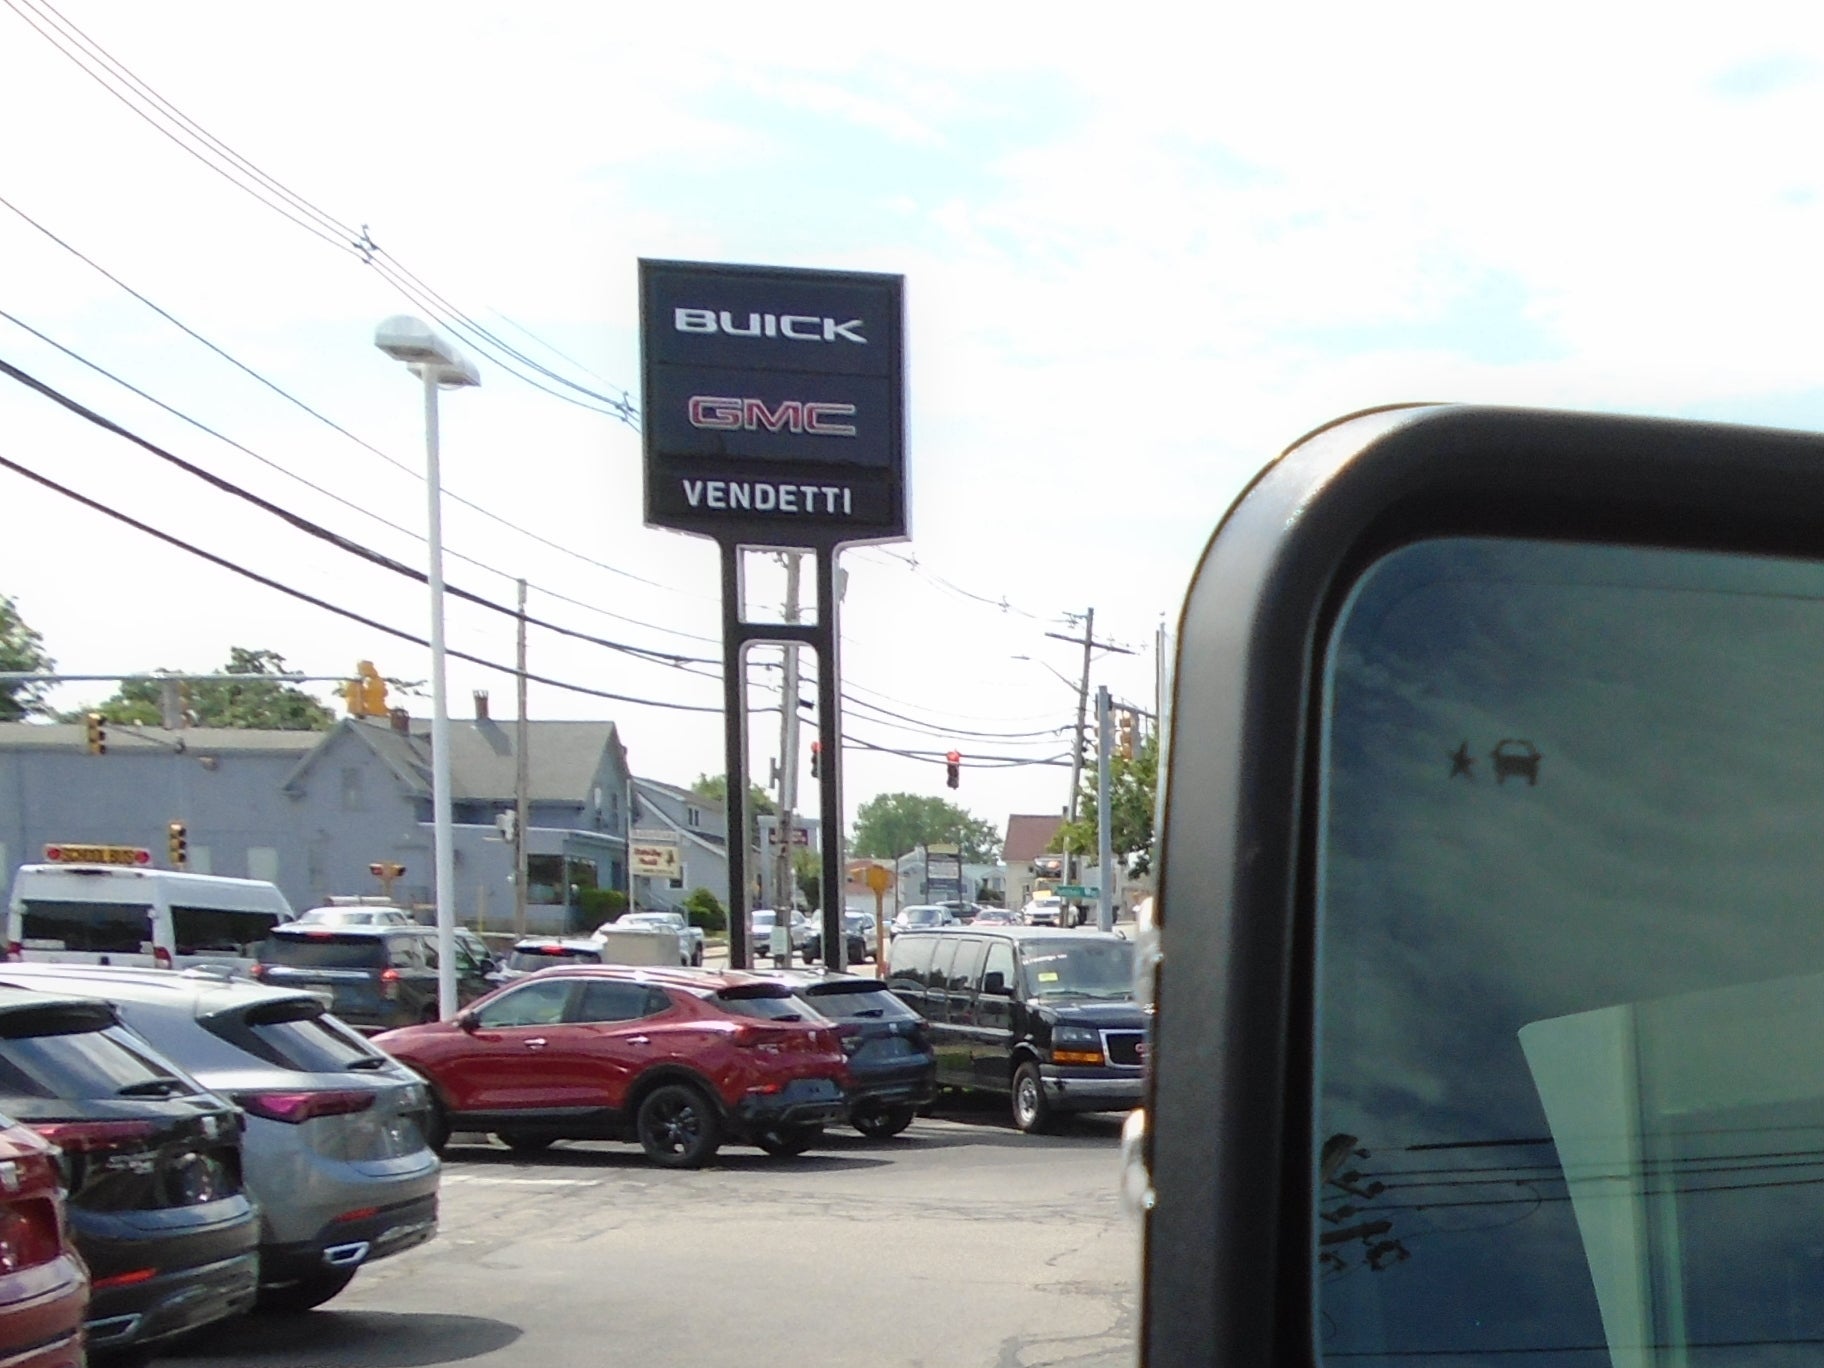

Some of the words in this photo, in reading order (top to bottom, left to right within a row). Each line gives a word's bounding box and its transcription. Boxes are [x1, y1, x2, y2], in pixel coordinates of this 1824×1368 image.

[674, 307, 868, 343] BUICK
[688, 395, 857, 437] GMC
[682, 479, 852, 515] VENDETTI
